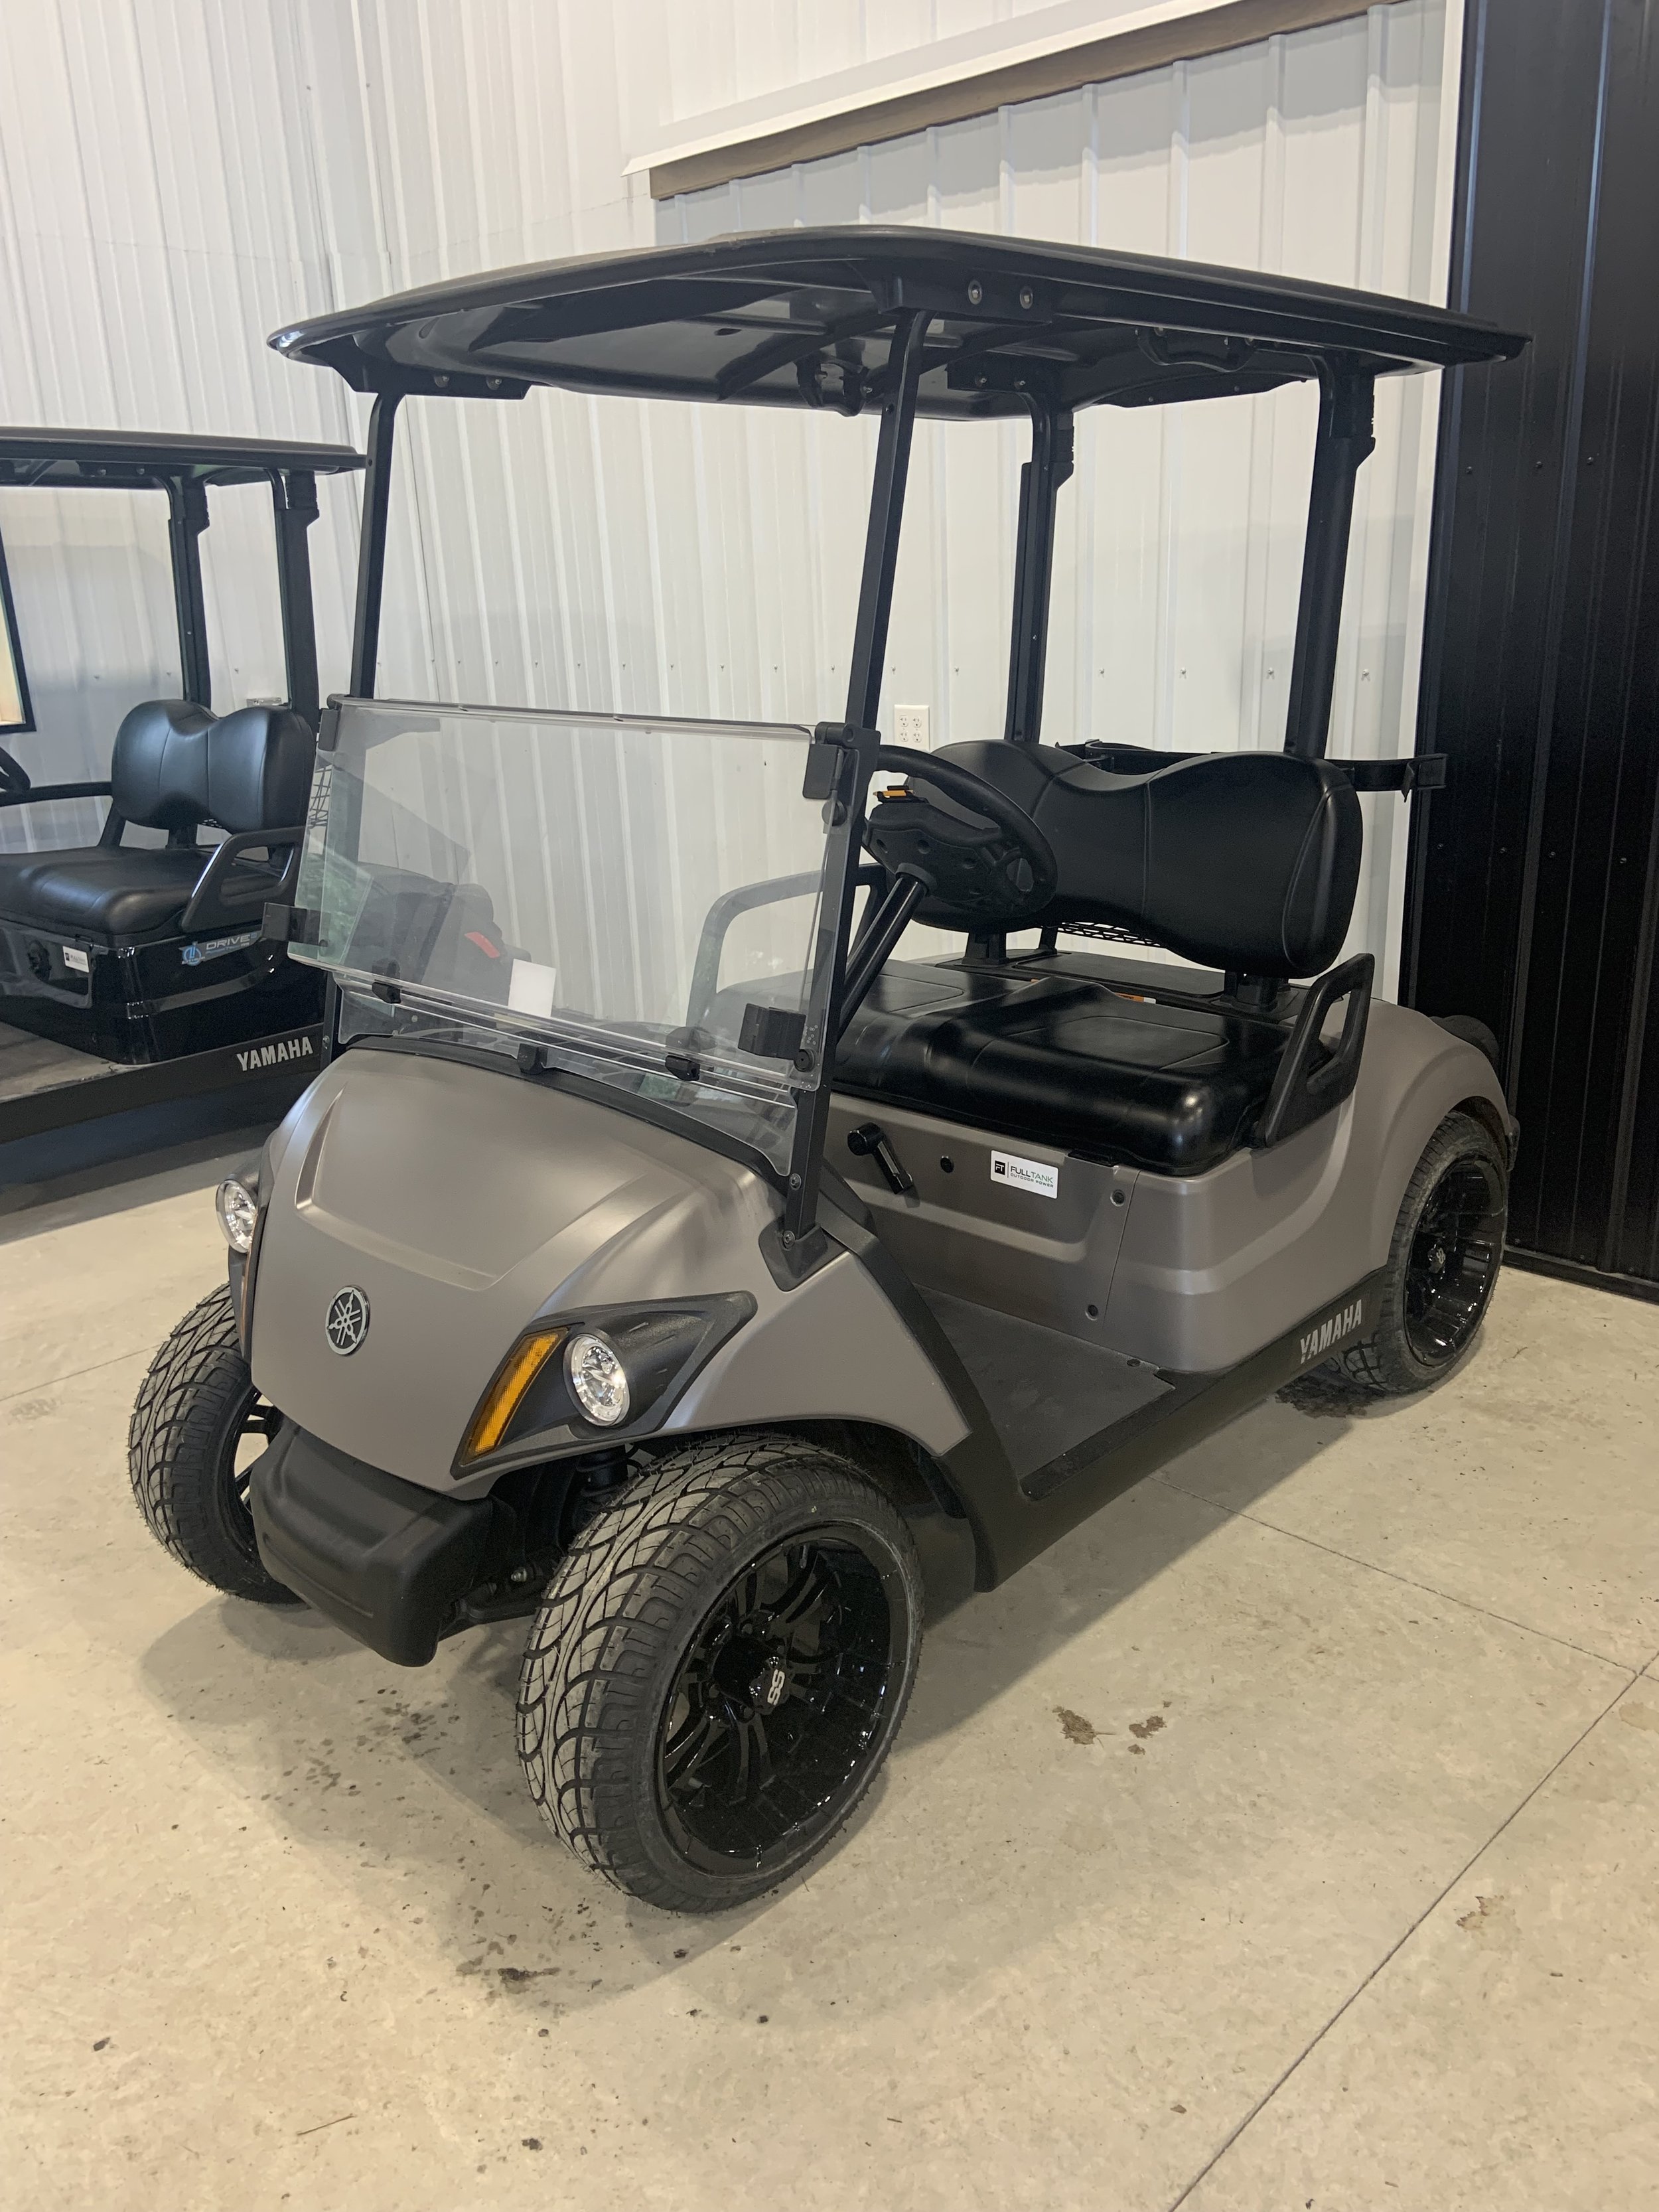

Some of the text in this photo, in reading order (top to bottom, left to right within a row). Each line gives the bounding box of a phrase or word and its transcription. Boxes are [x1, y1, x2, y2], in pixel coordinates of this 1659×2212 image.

[236, 1036, 313, 1071] YAMAHA
[1010, 1165, 1054, 1184] FULLTANK
[1010, 1173, 1035, 1183] OUTDOOR
[1300, 1299, 1362, 1364] YAMAHA
